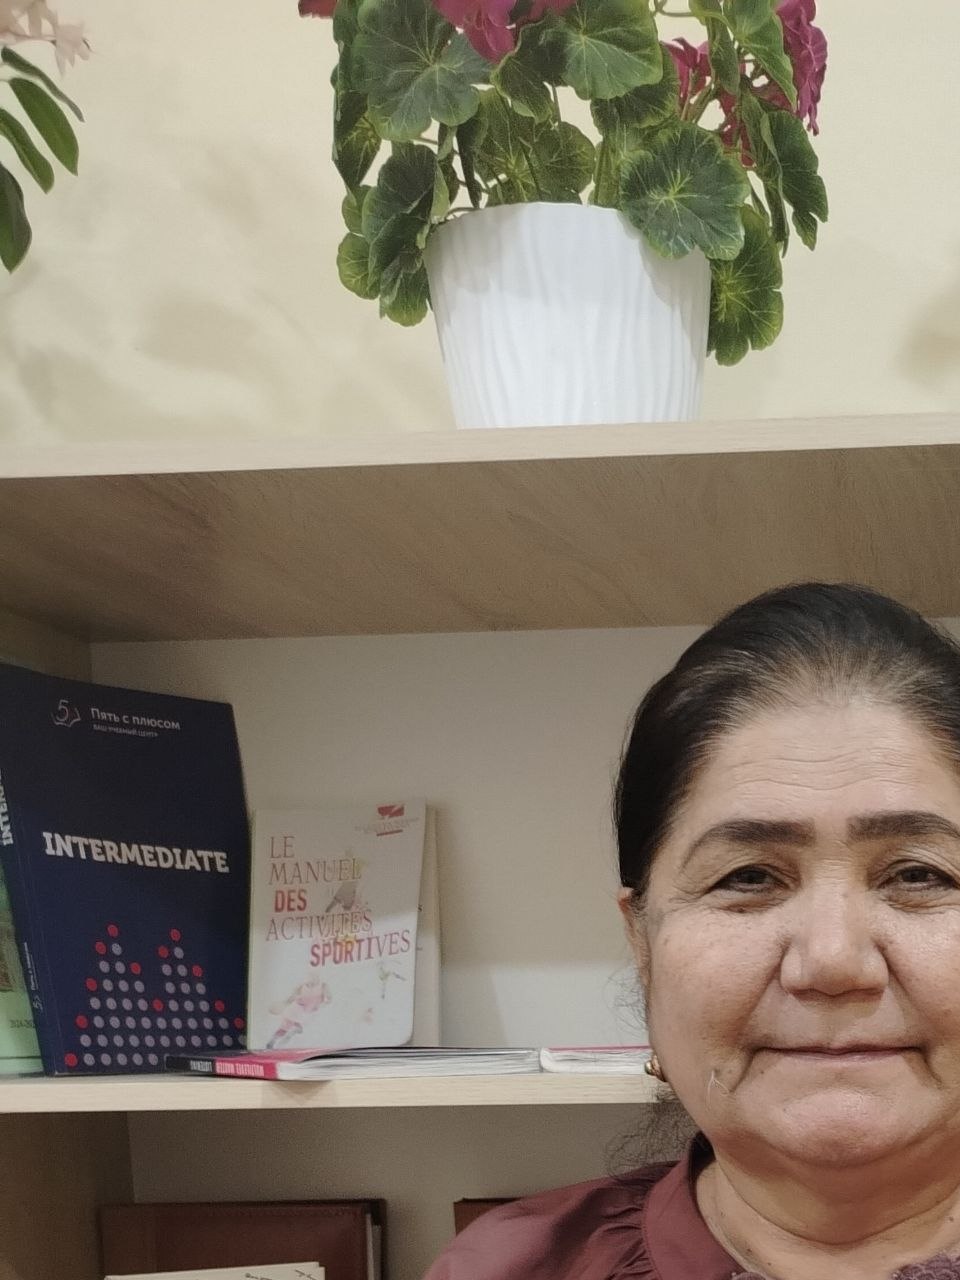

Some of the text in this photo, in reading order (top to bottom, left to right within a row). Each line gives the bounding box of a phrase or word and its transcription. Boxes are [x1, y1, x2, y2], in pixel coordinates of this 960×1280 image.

[91, 708, 120, 723] Пять
[132, 717, 181, 730] плюсом
[43, 831, 230, 873] INTERMEDIATE
[270, 836, 295, 859] LE
[268, 858, 362, 885] MANUEL
[274, 889, 308, 913] DES
[310, 929, 411, 967] SPORTIVES
